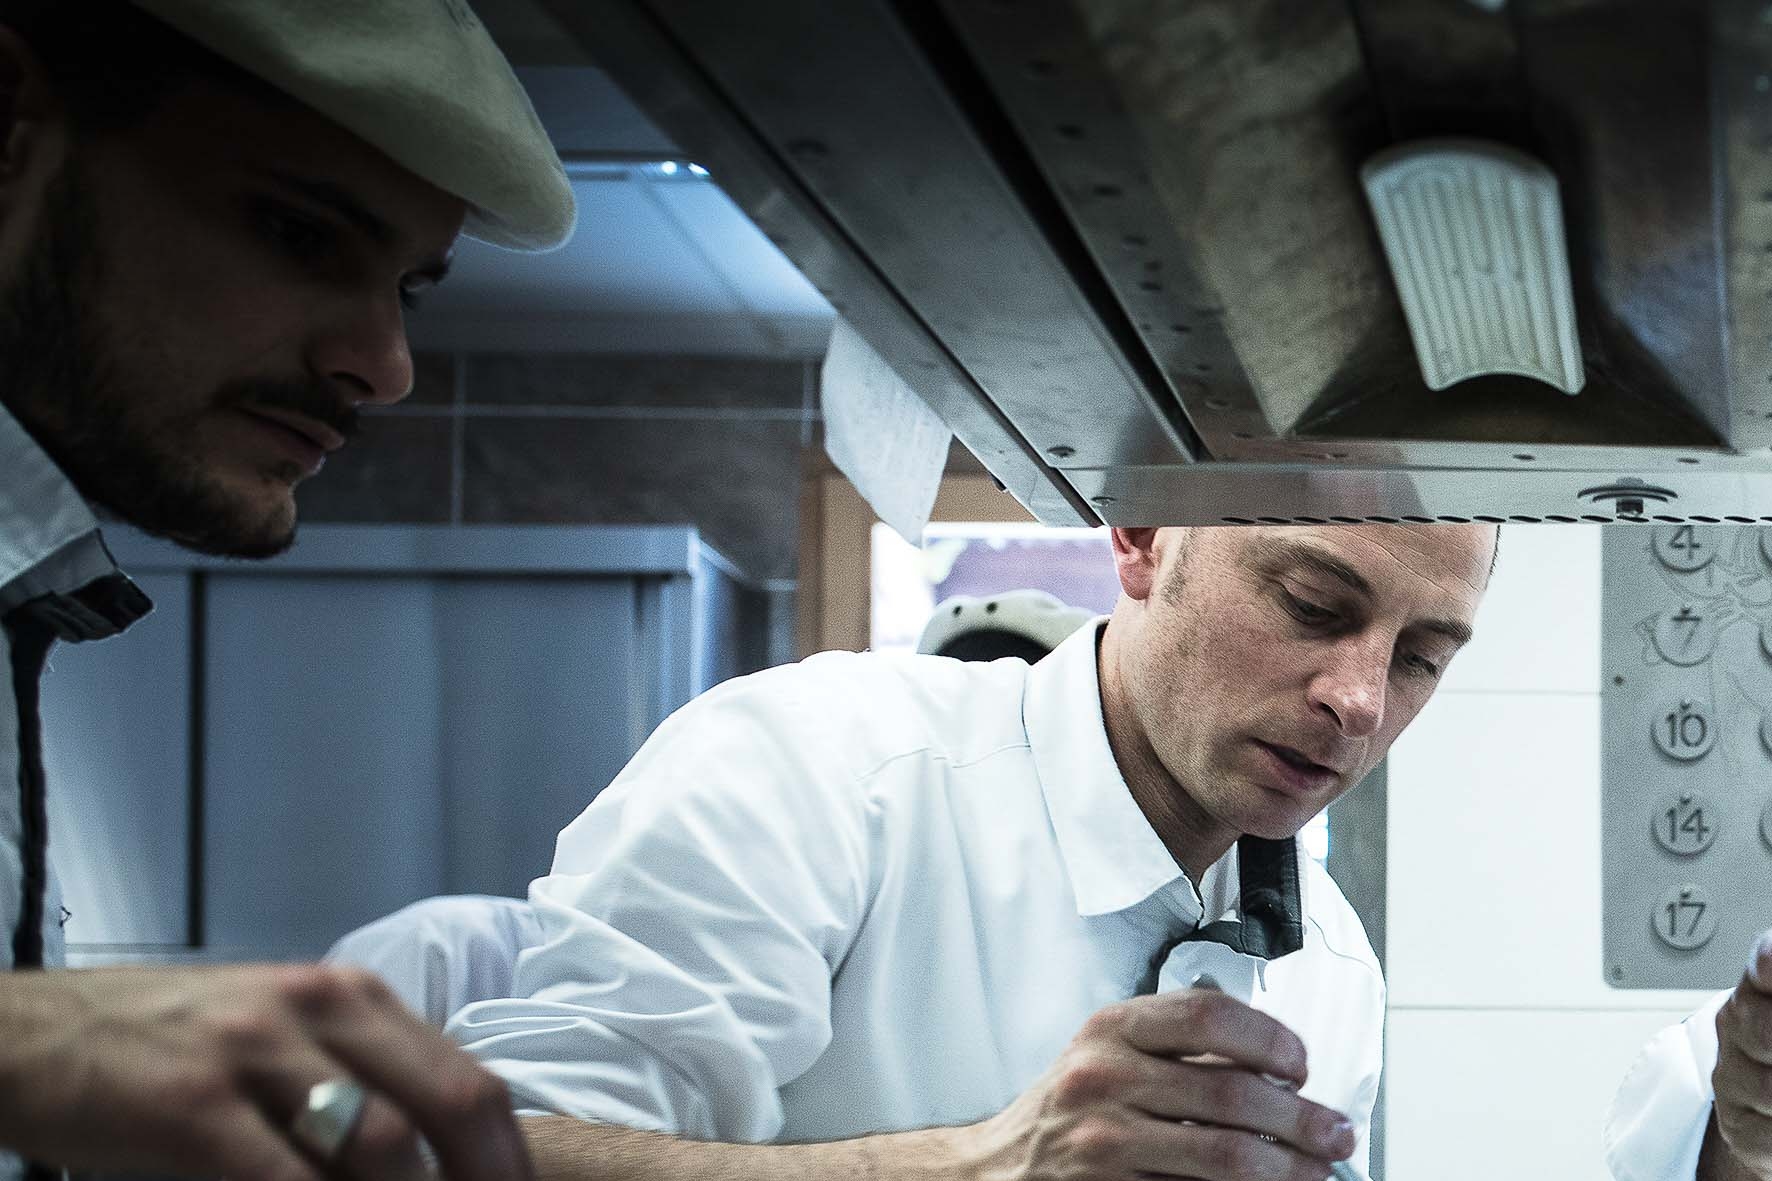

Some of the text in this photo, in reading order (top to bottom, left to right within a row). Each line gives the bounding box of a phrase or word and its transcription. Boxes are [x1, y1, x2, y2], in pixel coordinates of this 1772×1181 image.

[1669, 525, 1702, 560] 4
[1670, 616, 1703, 654] 7
[1664, 712, 1708, 748] 10
[1665, 806, 1710, 844] 14
[1665, 901, 1706, 937] 17
